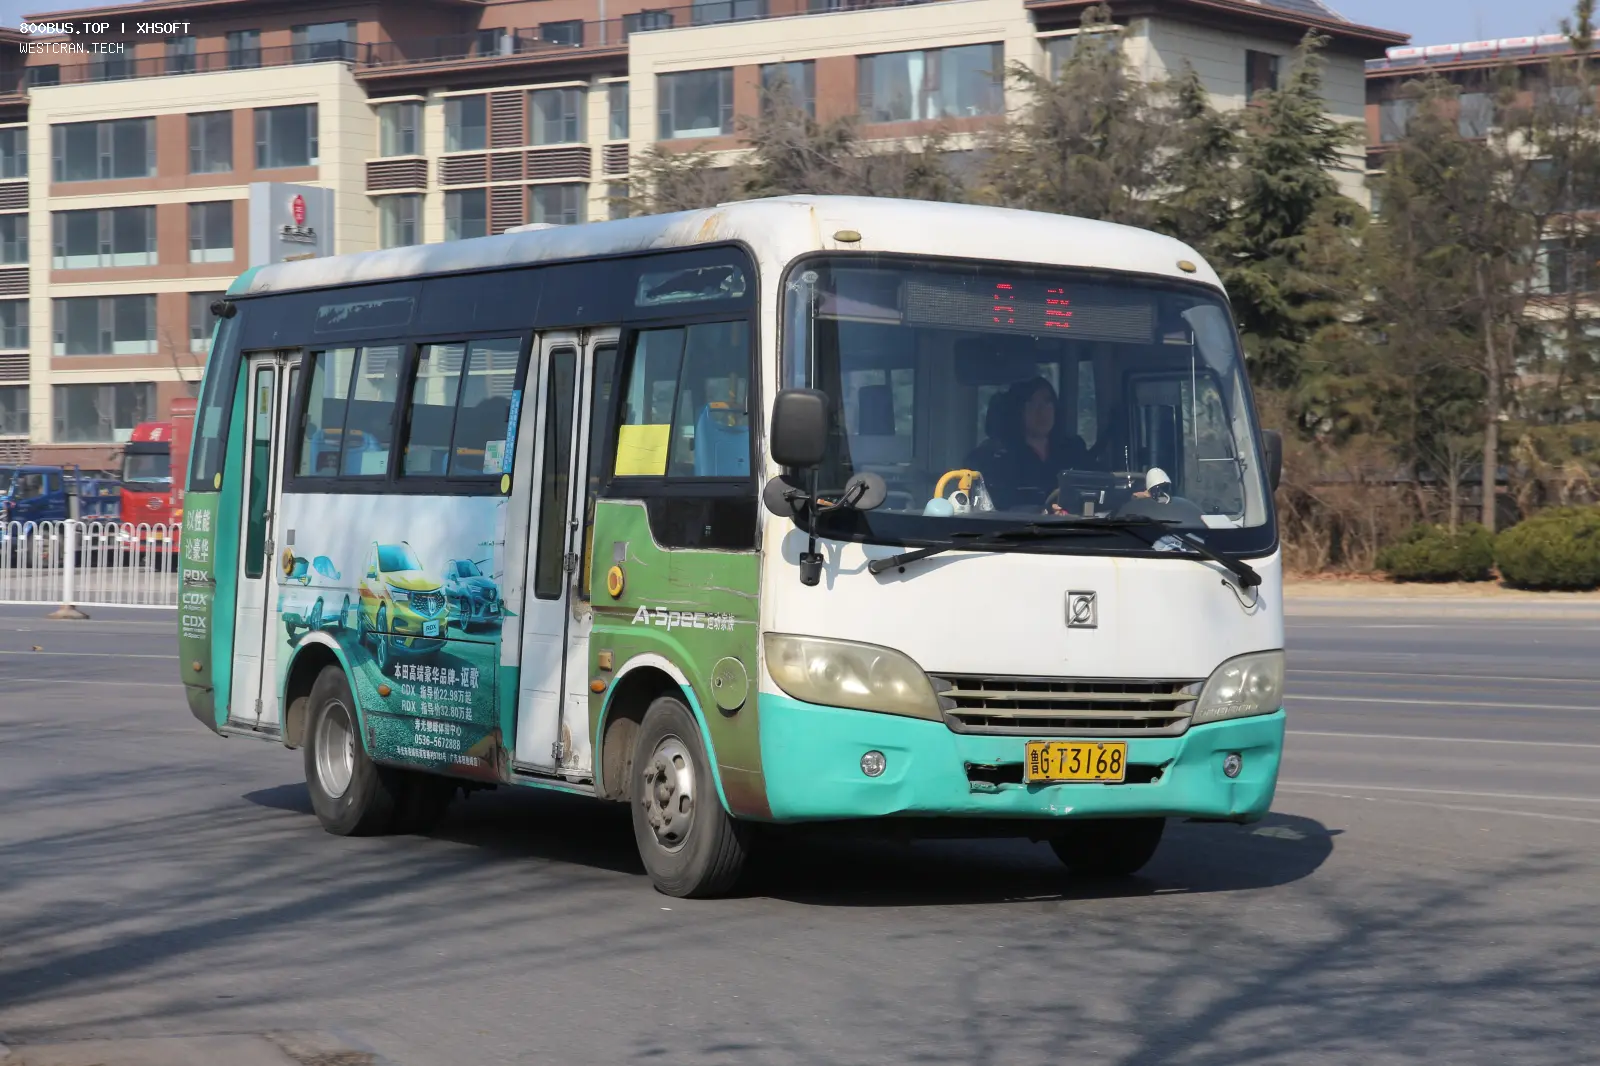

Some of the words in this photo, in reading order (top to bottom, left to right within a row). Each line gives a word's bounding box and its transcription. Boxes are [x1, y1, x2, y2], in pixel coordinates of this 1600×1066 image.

[187, 509, 211, 532] 以性能
[185, 538, 209, 562] 论豪华
[182, 593, 208, 606] CDX
[182, 614, 207, 629] CDX
[631, 605, 706, 632] A-Spec
[401, 683, 416, 697] CDX
[401, 699, 417, 712] RDX
[414, 733, 461, 750] 0536-5672888
